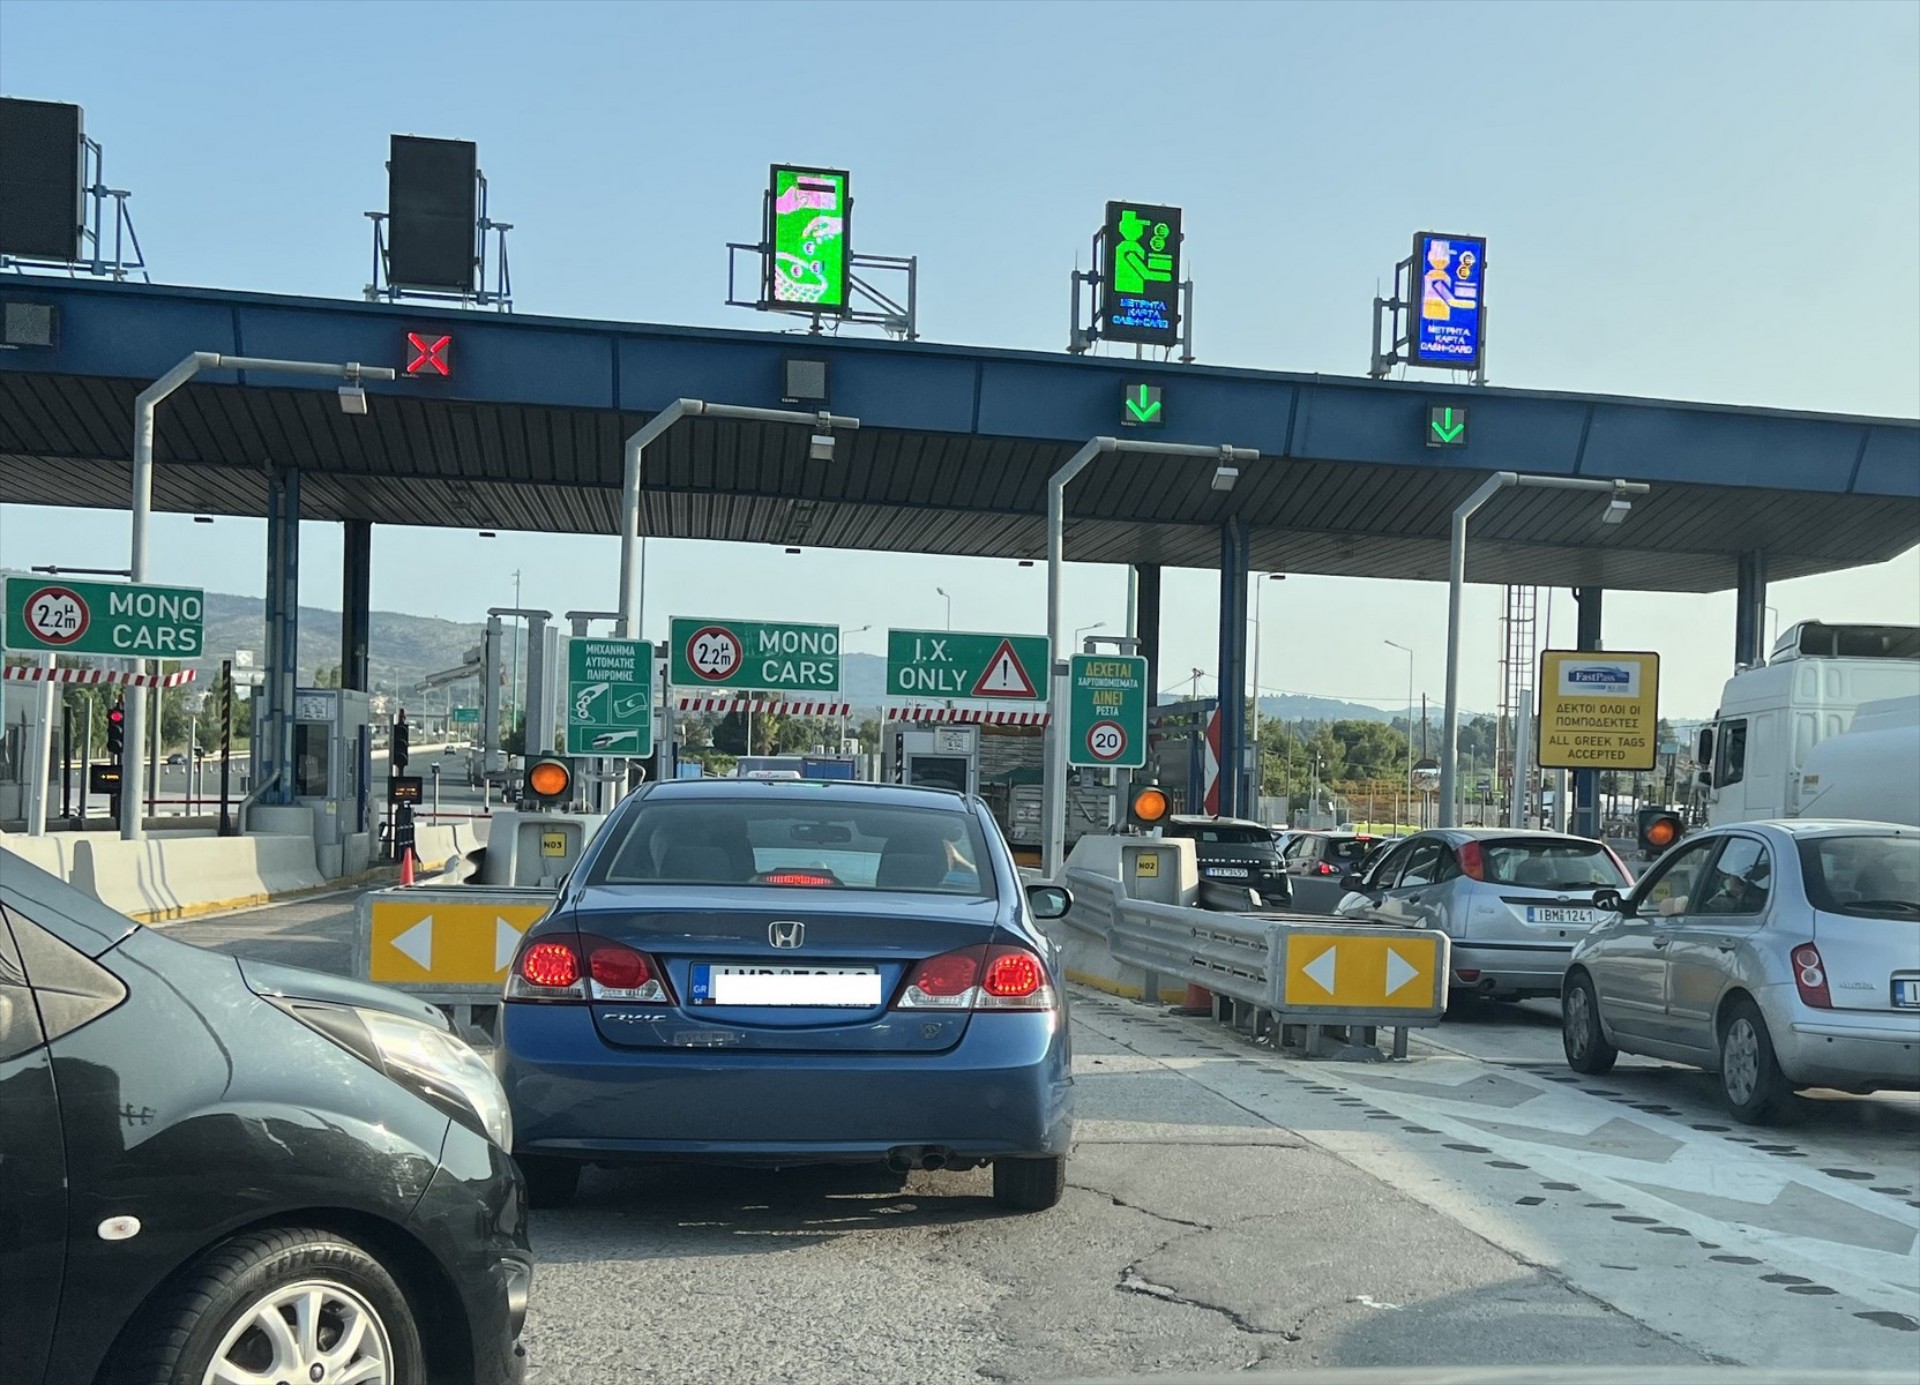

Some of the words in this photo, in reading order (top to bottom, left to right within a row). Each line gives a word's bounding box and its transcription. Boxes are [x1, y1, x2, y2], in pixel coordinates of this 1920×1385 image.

[109, 591, 201, 622] MONO
[113, 623, 198, 651] CARS
[759, 629, 838, 655] MONO
[585, 643, 636, 657] ΜΗΧΑΝΗΜΑ
[914, 638, 953, 662] I.X.
[585, 656, 636, 669] ΑΥΤΟΜΑΤΗΣ
[587, 669, 634, 681] ΠΛΗΡΩΜΗΣ
[761, 659, 835, 685] CARS
[1085, 662, 1132, 678] ΔΕΧΕΤΑΙ
[1575, 671, 1616, 682] FastPass
[899, 667, 967, 691] ONLY
[1092, 690, 1123, 706] ΔΙΝΕΙ
[1096, 705, 1119, 717] ΡΕΣΤΑ
[1556, 703, 1596, 714] ΔΕΚΤΟΙ
[1600, 704, 1626, 715] ΟΛΟΙ
[1629, 706, 1641, 716] ΟΙ
[1555, 716, 1640, 729] ΠΟΜΠΟΔΕΚΤΕΣ
[1095, 733, 1118, 748] 20
[1549, 735, 1570, 746] ALL
[1574, 736, 1612, 747] GREEK
[1617, 737, 1646, 748] TAGS
[1567, 749, 1626, 760] ACCEPTED
